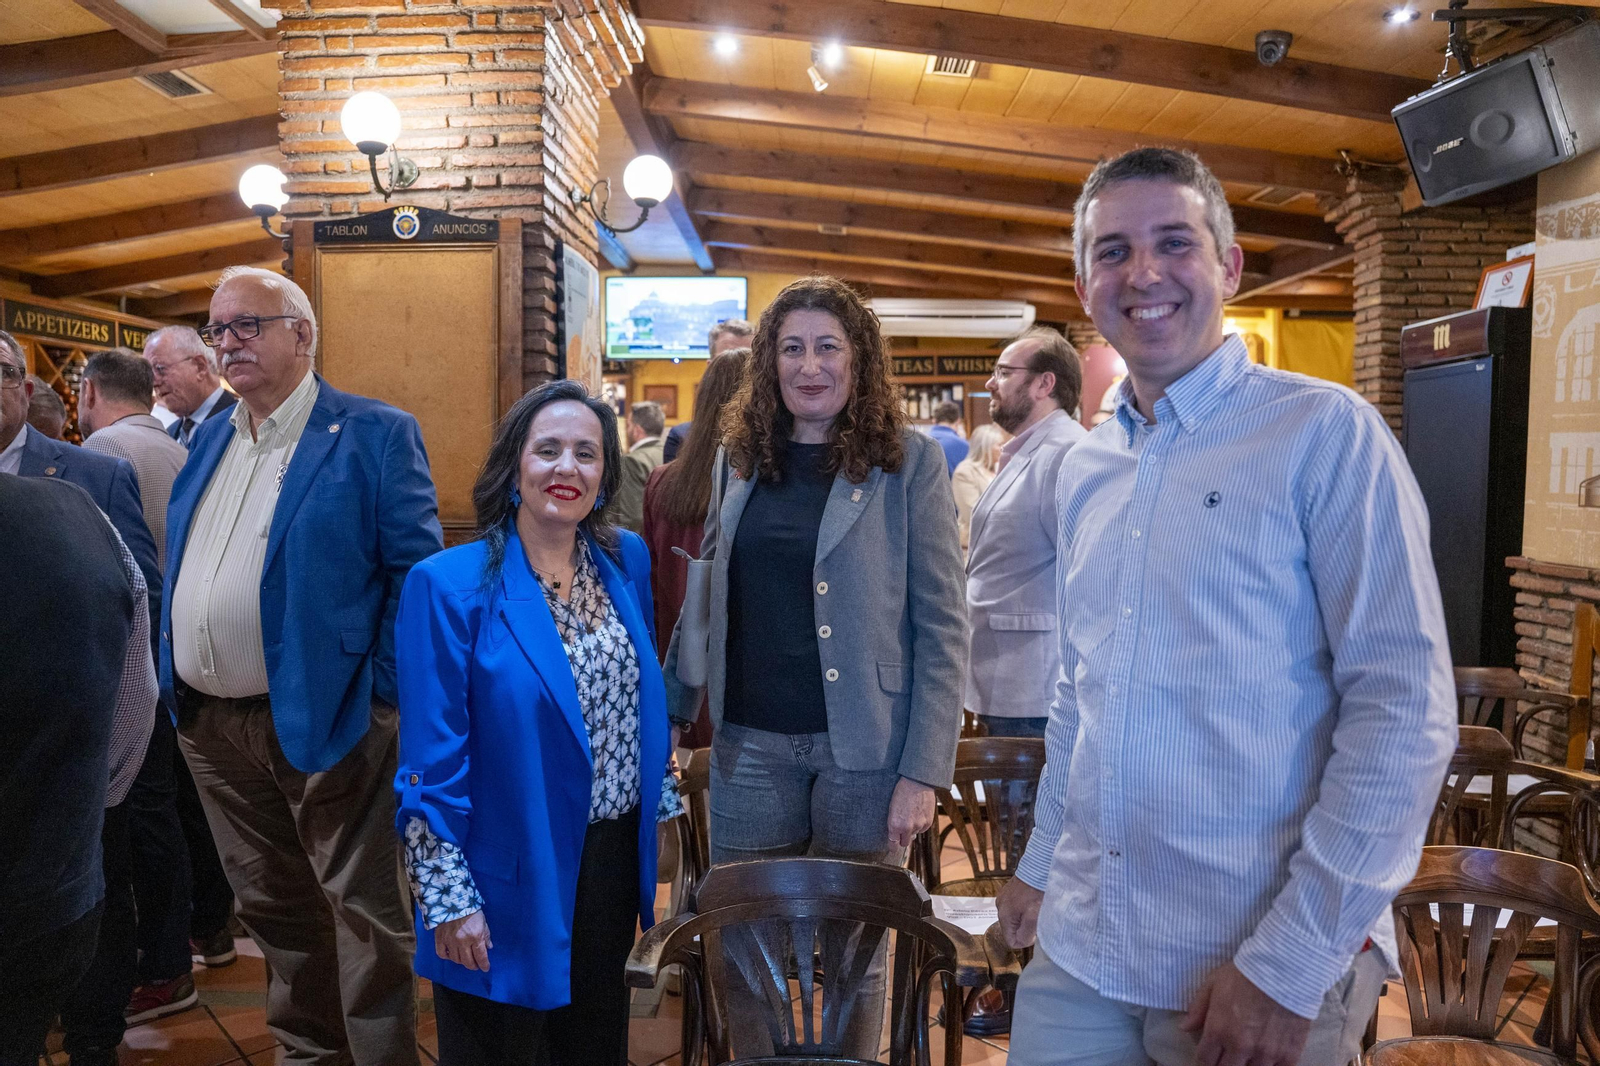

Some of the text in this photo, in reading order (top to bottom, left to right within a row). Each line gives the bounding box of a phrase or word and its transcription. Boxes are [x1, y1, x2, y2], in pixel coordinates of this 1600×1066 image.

[1433, 138, 1463, 155] BOSE
[324, 223, 487, 236] TABLON ANUNCIOS
[14, 310, 109, 342] APPETIZERS
